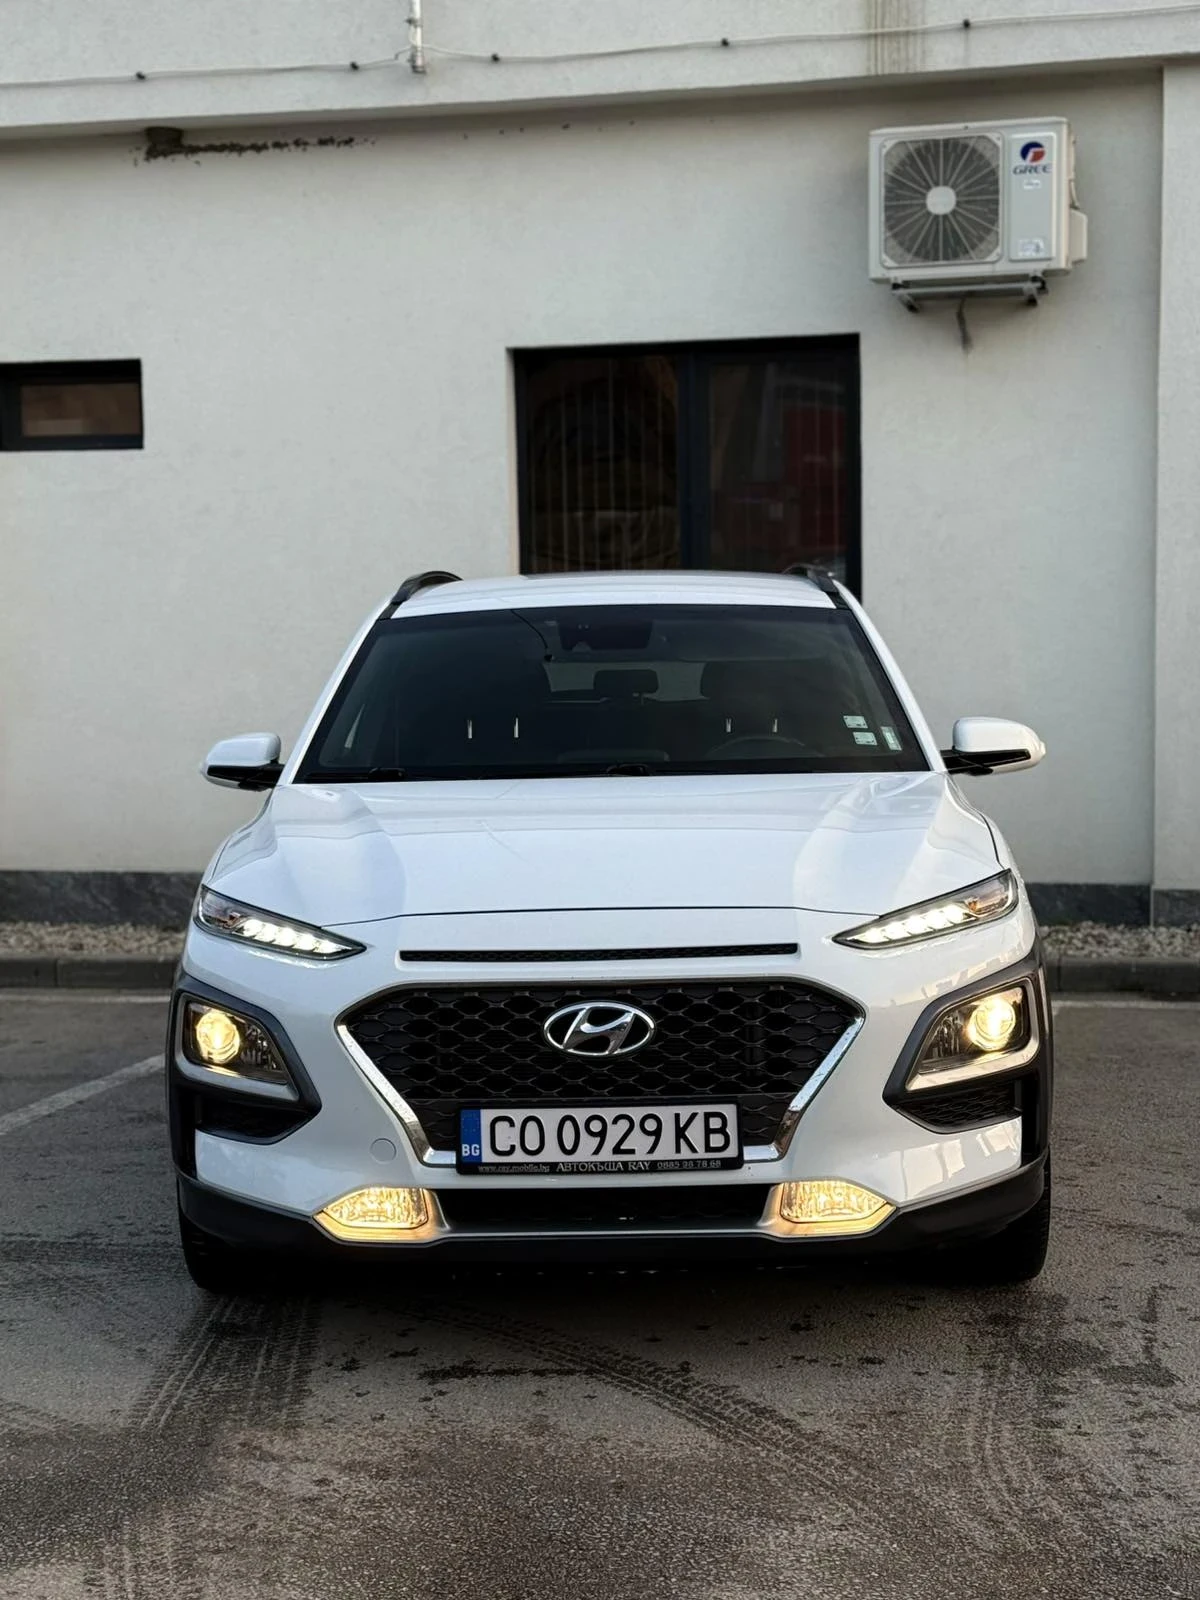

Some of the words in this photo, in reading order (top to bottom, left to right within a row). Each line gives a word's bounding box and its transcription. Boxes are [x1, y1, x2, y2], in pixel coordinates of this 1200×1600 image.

[556, 1113, 663, 1156] 0929
[461, 1143, 480, 1157] BG
[628, 1161, 651, 1171] RAY
